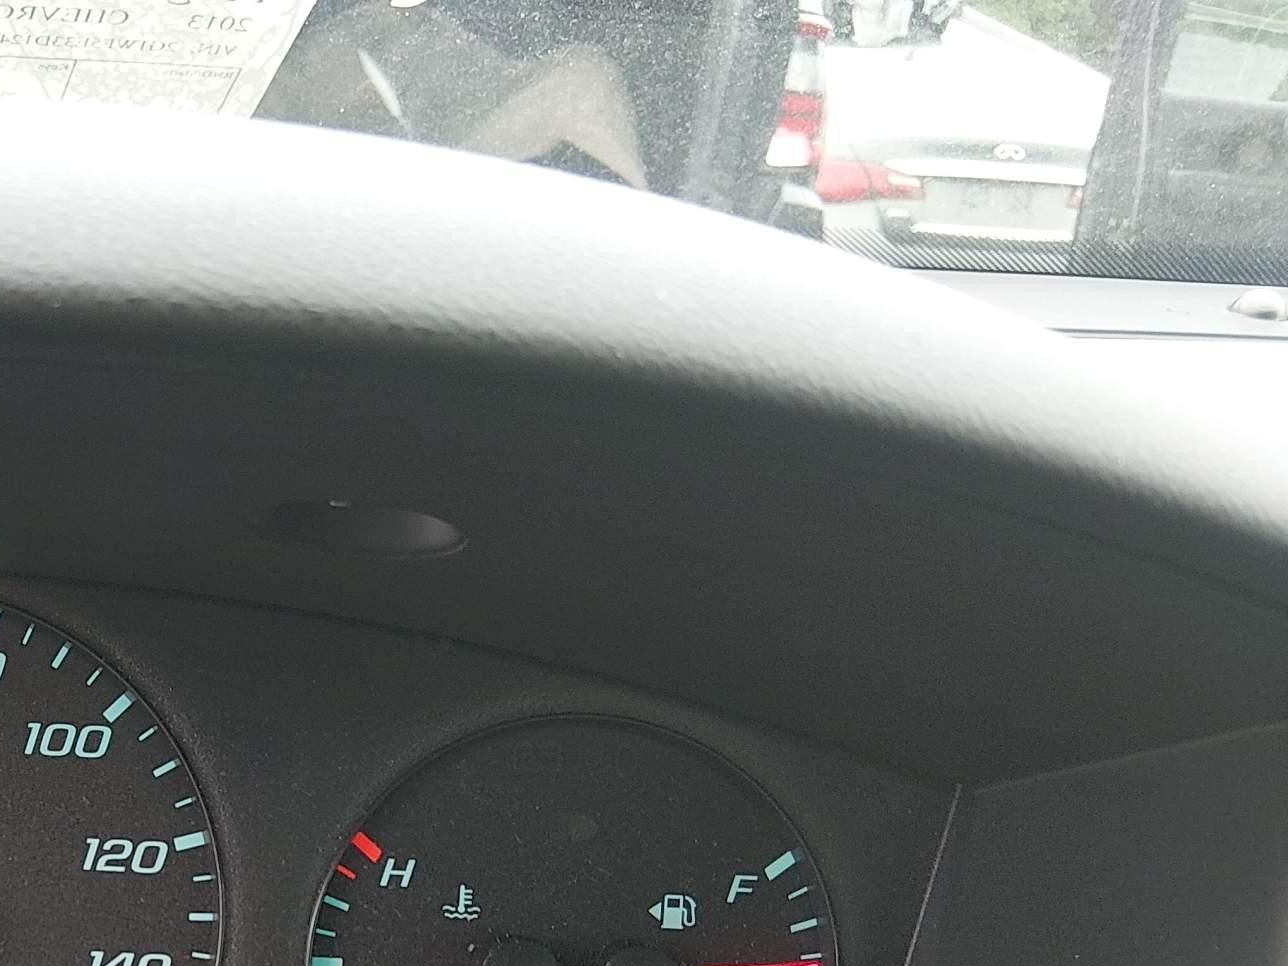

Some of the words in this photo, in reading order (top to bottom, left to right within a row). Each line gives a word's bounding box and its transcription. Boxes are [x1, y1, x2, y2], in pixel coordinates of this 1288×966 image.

[24, 720, 112, 759] 100
[82, 837, 169, 874] 120
[379, 858, 416, 888] H
[726, 874, 758, 903] F
